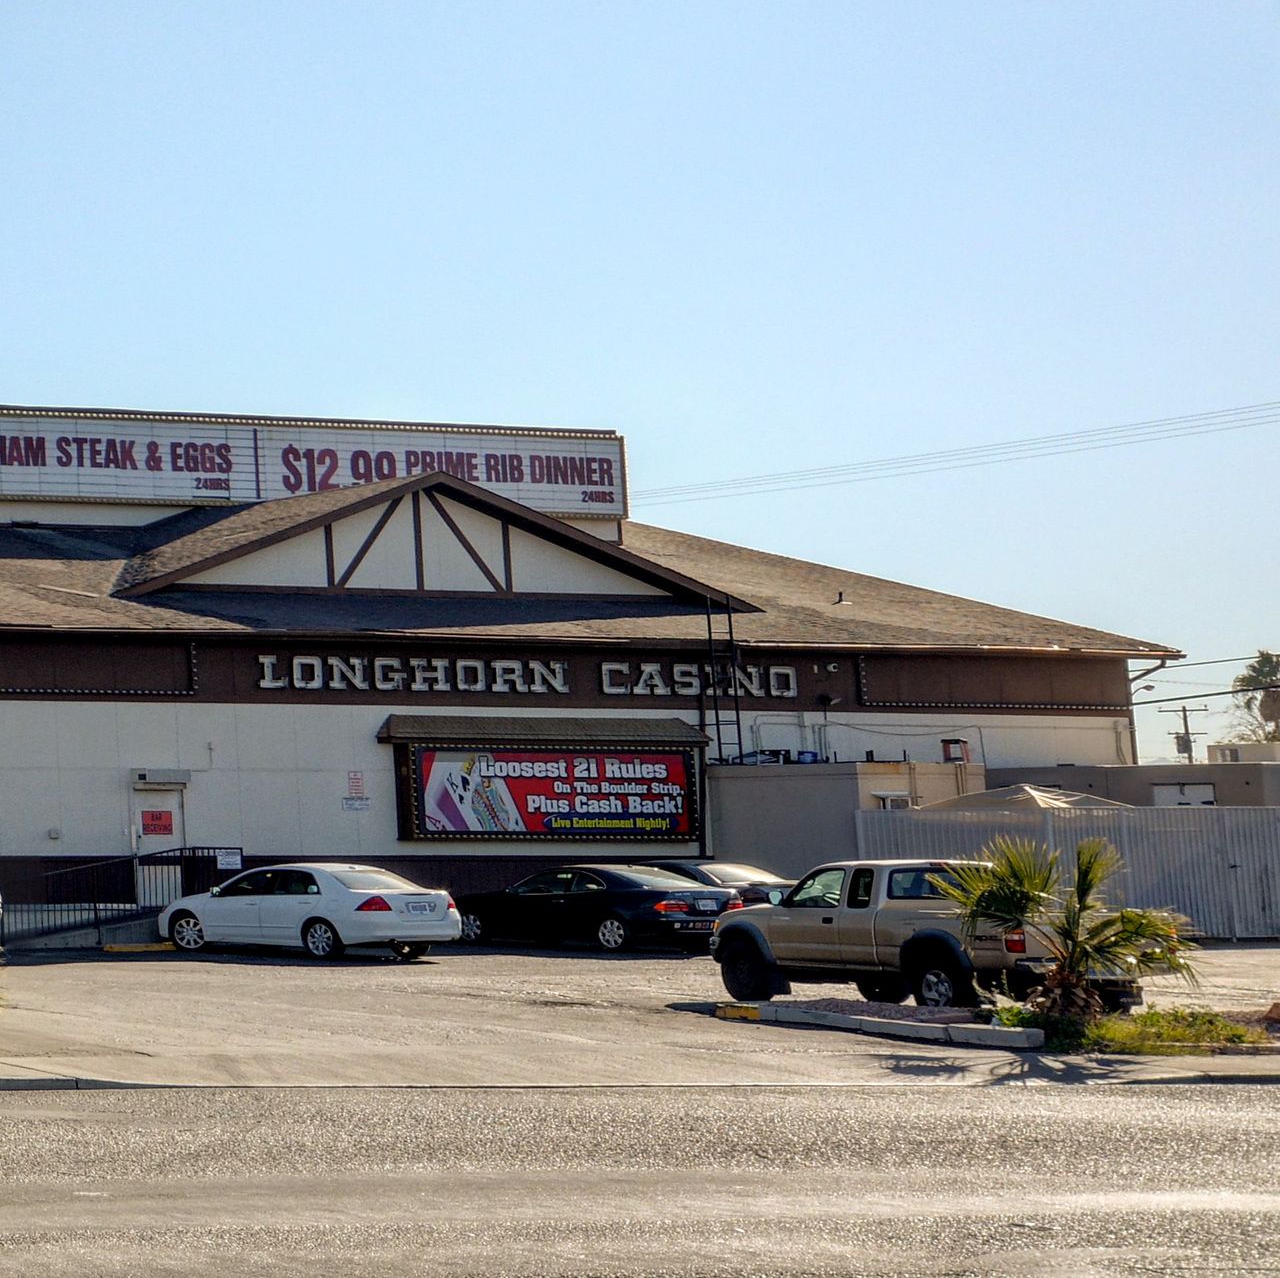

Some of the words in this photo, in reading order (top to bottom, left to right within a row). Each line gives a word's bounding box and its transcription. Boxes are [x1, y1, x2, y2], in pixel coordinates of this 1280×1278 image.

[56, 437, 139, 471] STEAK
[145, 441, 163, 472] &
[170, 442, 233, 474] EGGS
[405, 450, 478, 483] PRIME
[485, 453, 525, 484] RIB
[529, 454, 615, 487] DINNER
[194, 476, 231, 492] 24HRS
[581, 490, 615, 504] 24HRS
[258, 654, 570, 693] LONGHORN
[600, 661, 798, 698] CASINO
[478, 755, 567, 778] Loosest
[573, 758, 599, 778] 21
[604, 759, 668, 779] Rules
[553, 780, 571, 794] On
[573, 781, 599, 794] The
[600, 781, 650, 794] Boulder
[650, 782, 684, 796] Strip,
[526, 795, 571, 813] Plus
[574, 796, 624, 813] Cash
[627, 795, 684, 814] Back!
[551, 817, 571, 828] Live
[572, 817, 634, 829] Entertainment
